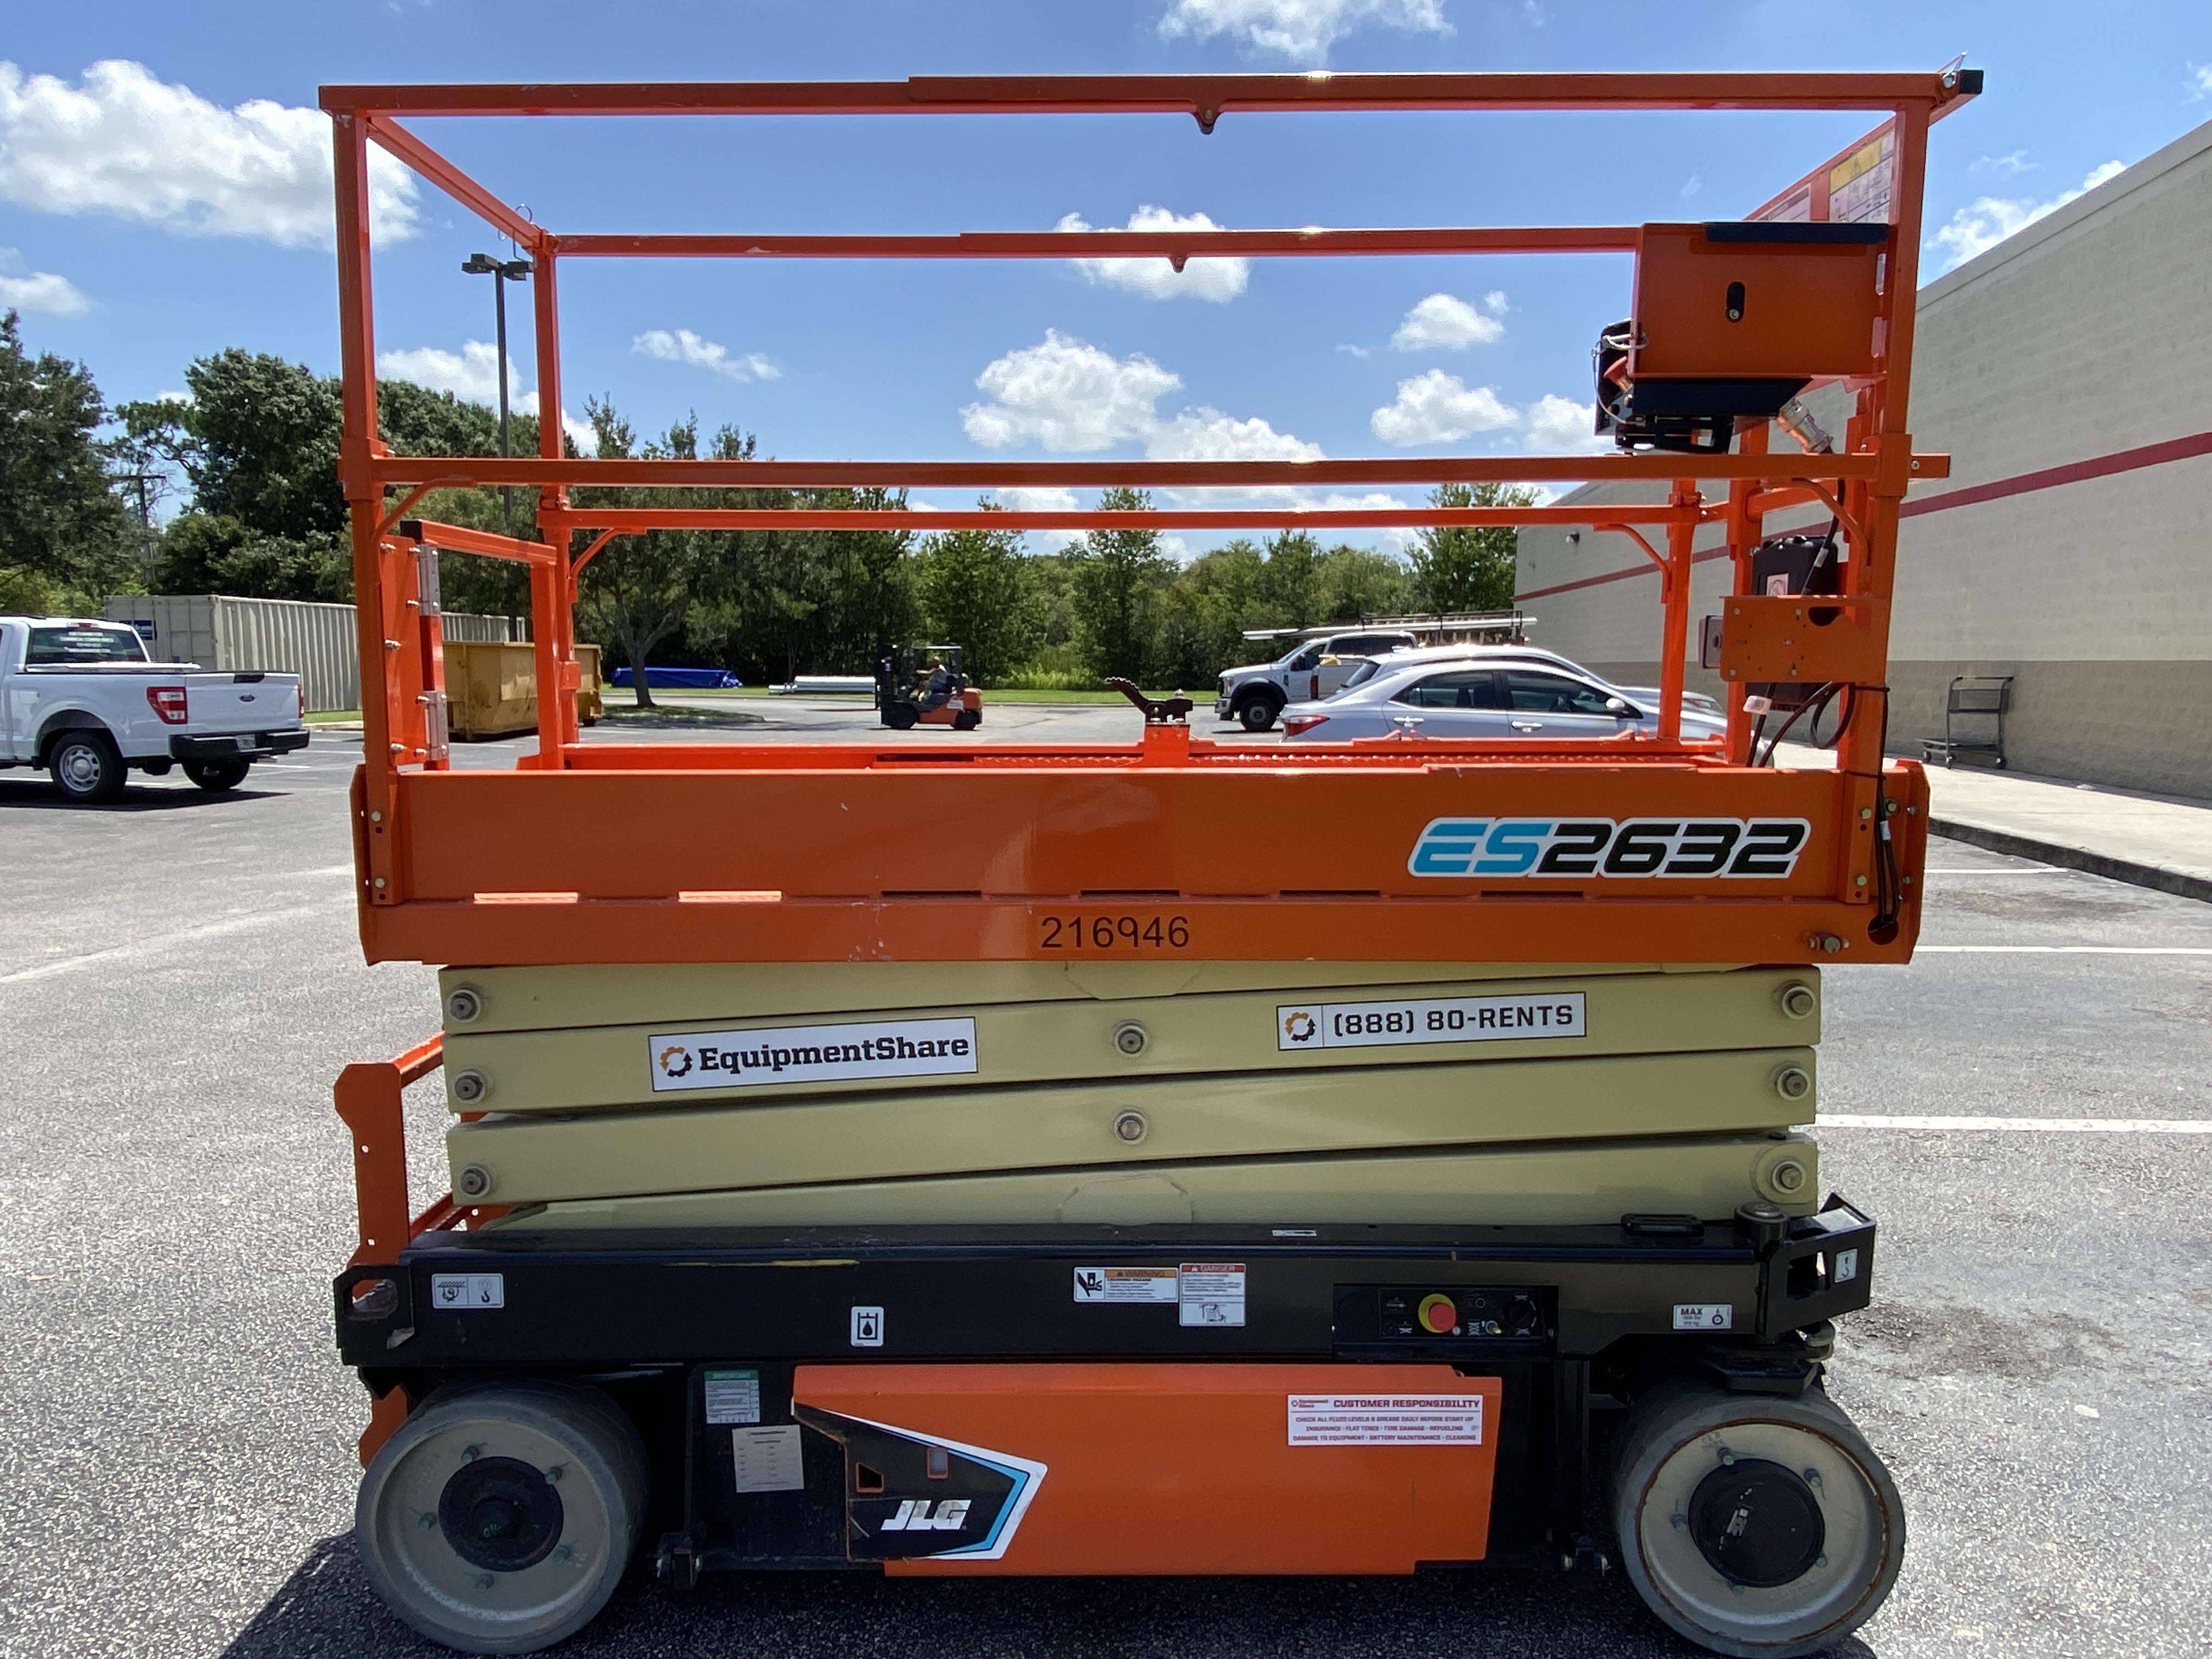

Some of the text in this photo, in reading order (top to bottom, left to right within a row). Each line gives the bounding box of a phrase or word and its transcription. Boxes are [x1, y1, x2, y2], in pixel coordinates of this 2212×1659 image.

[1411, 820, 1808, 876] ES2632
[1041, 916, 1189, 948] 216946
[1334, 1005, 1573, 1037] (888) 80-RENTS
[698, 1036, 969, 1074] EquipmentShare
[1333, 1400, 1390, 1408] CUSTOMER
[1392, 1400, 1480, 1408] RESPONSIBILITY
[881, 1500, 972, 1530] JLG
